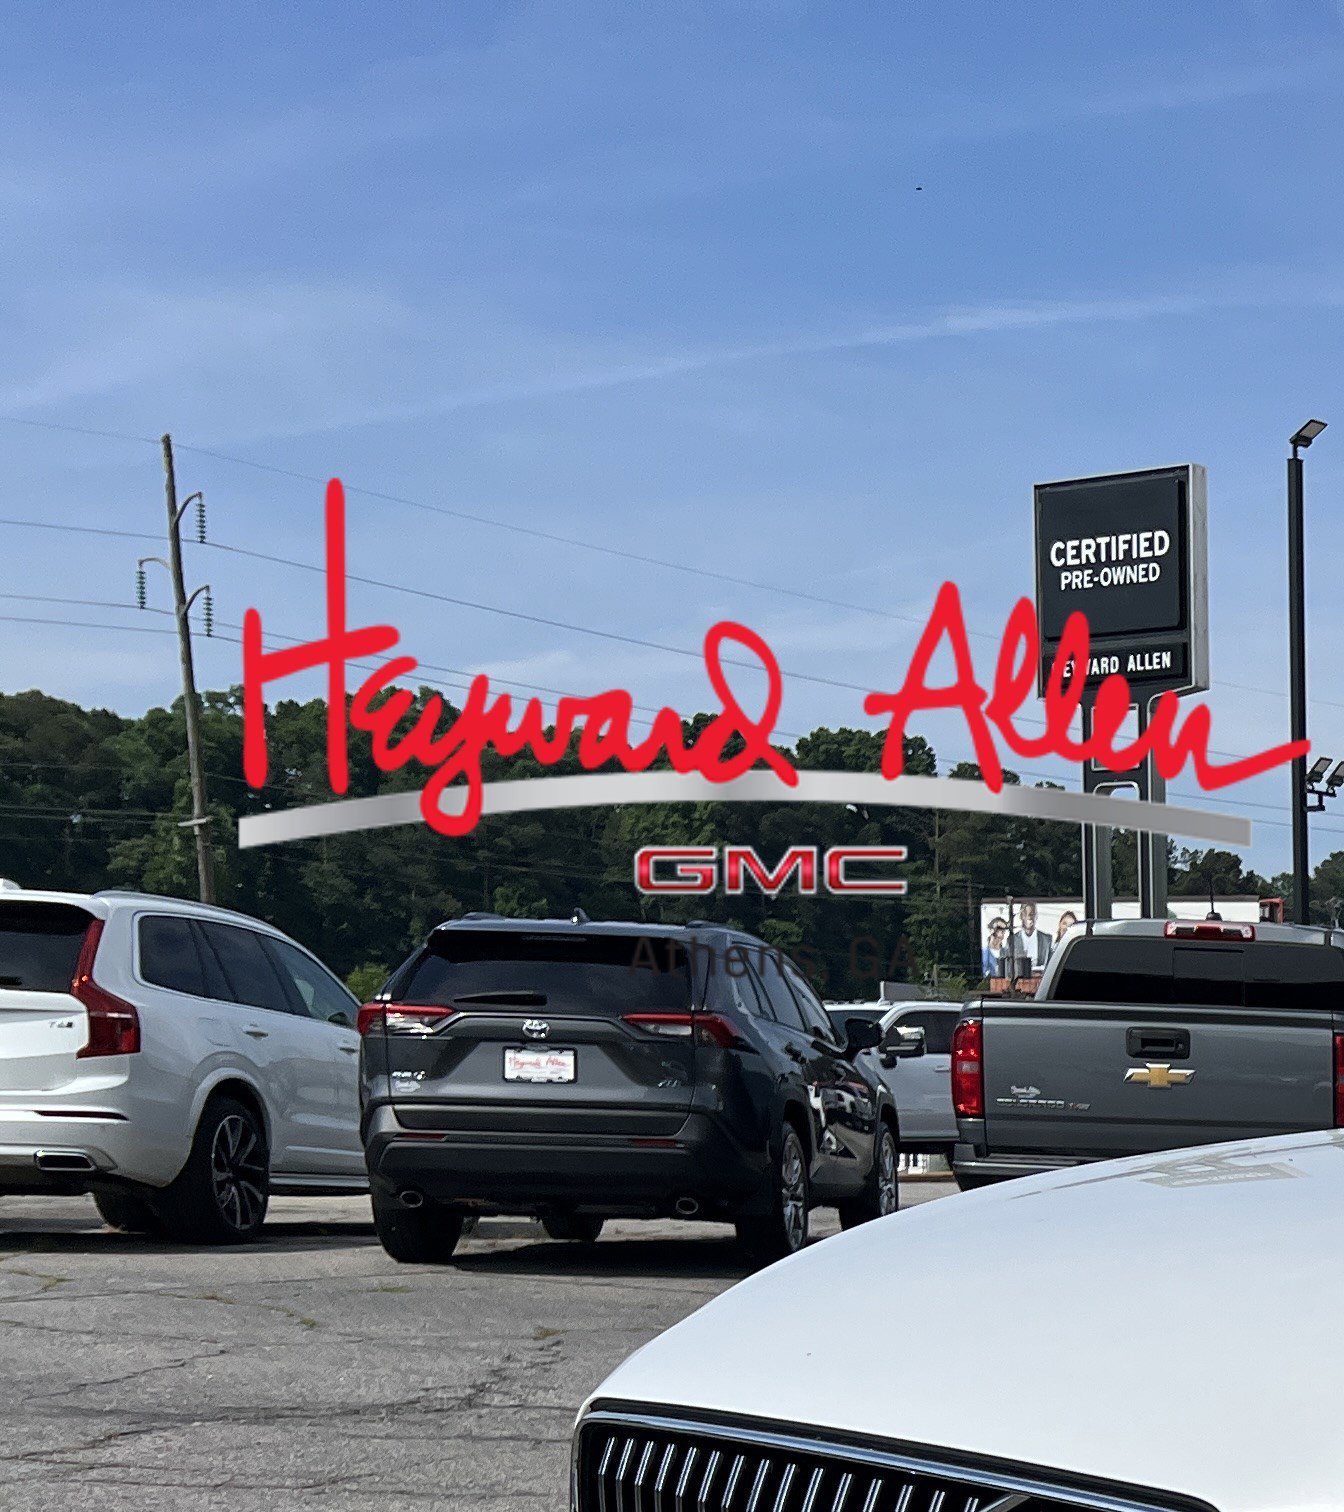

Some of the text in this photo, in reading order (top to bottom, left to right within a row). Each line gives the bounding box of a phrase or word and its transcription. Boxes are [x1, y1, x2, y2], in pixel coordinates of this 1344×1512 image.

[1050, 530, 1170, 567] CERTIFIED
[1060, 562, 1161, 591] PRE-OWNED
[1127, 651, 1172, 673] ALLEN
